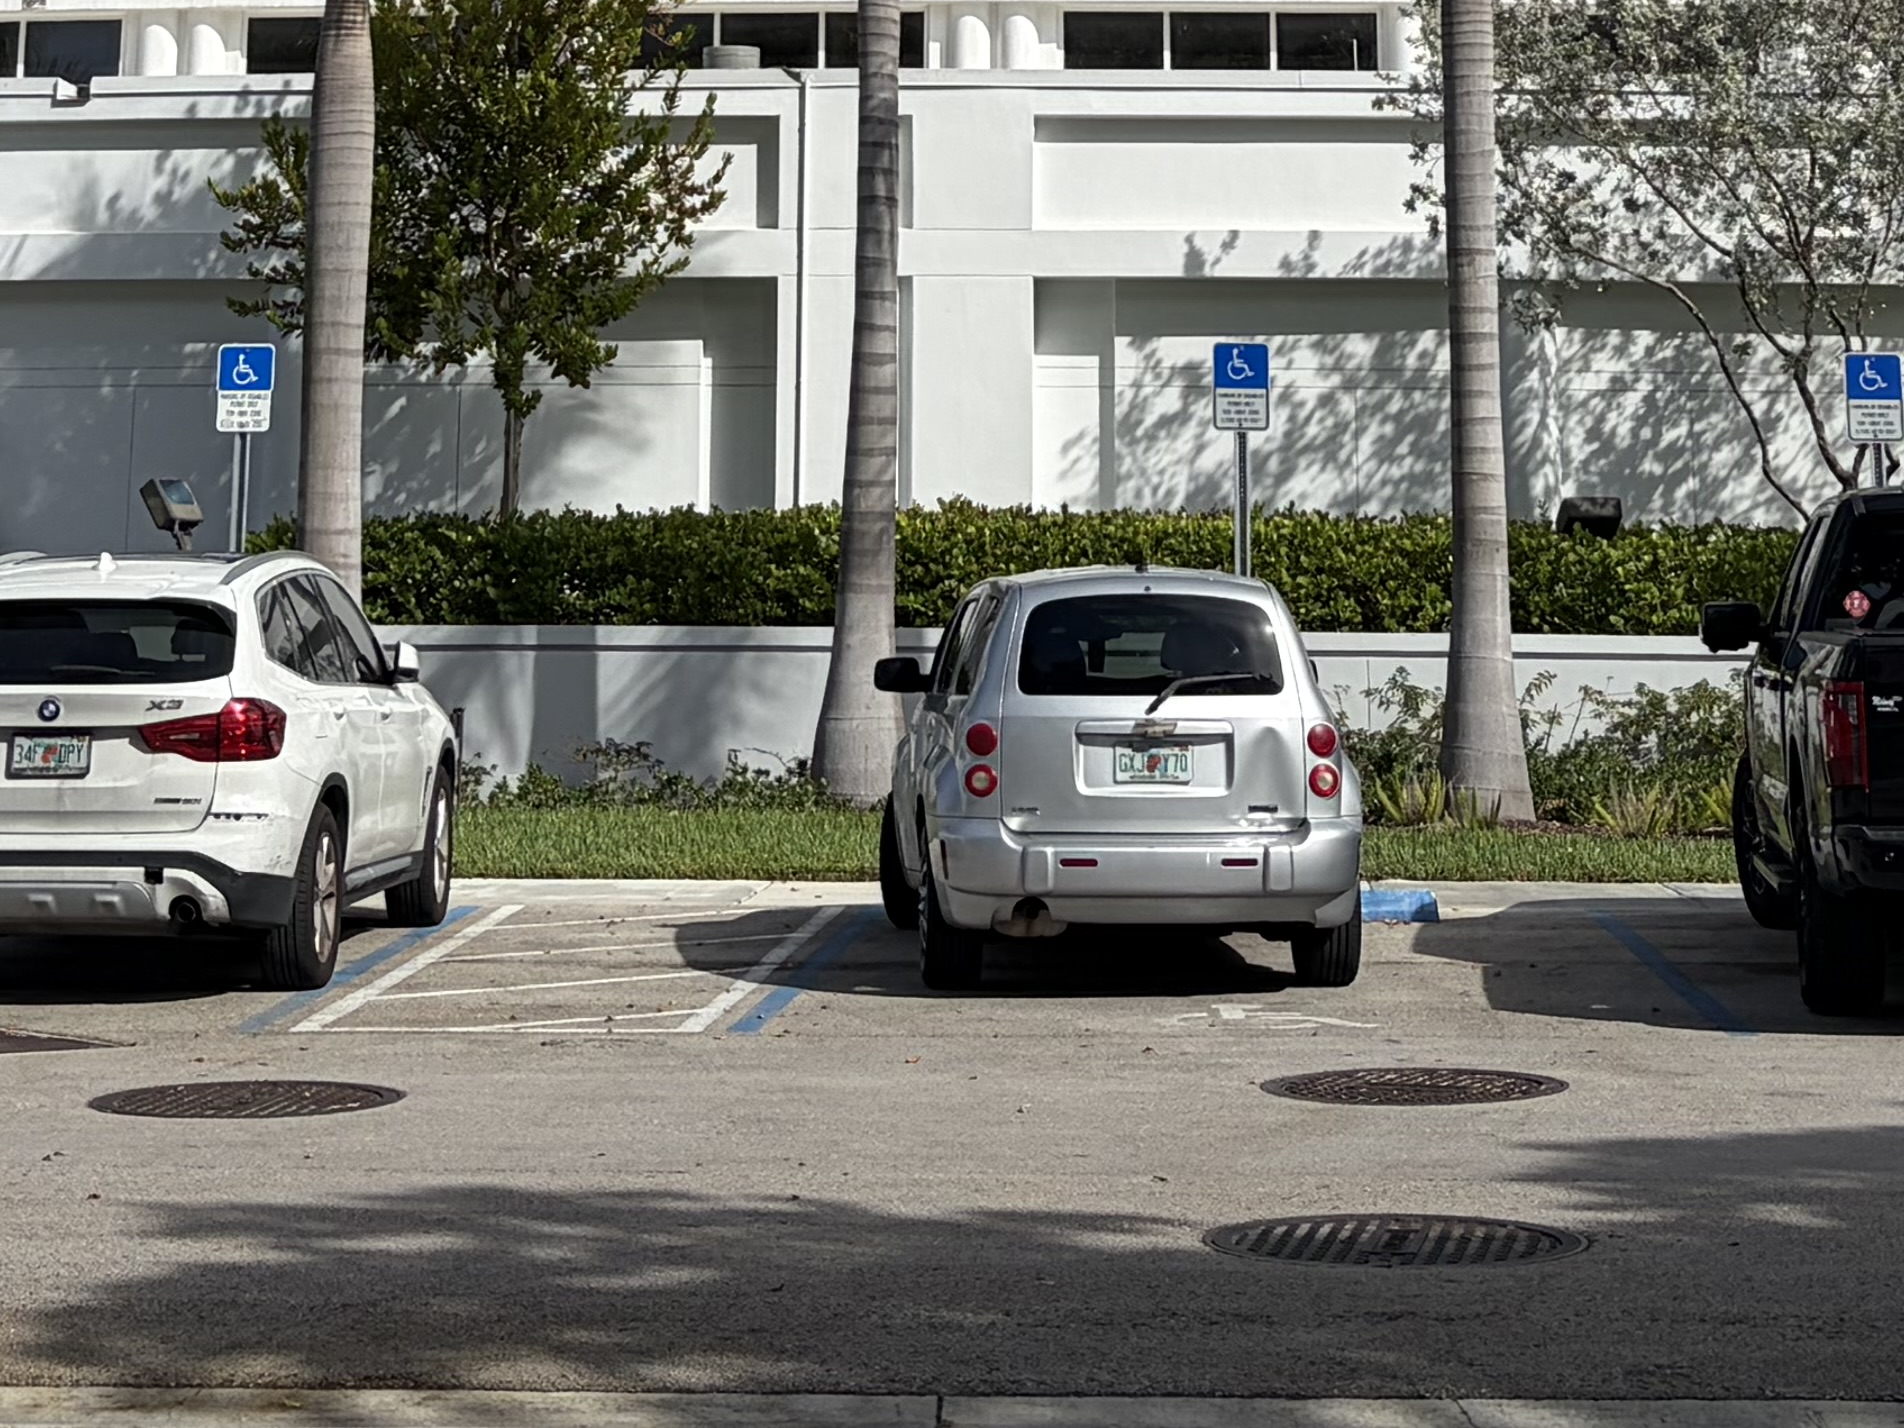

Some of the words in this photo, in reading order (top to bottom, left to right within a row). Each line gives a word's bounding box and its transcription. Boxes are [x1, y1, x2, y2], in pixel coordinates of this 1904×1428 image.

[145, 699, 184, 712] X3
[1118, 752, 1145, 773] GXJ
[1161, 752, 1189, 773] Y70
